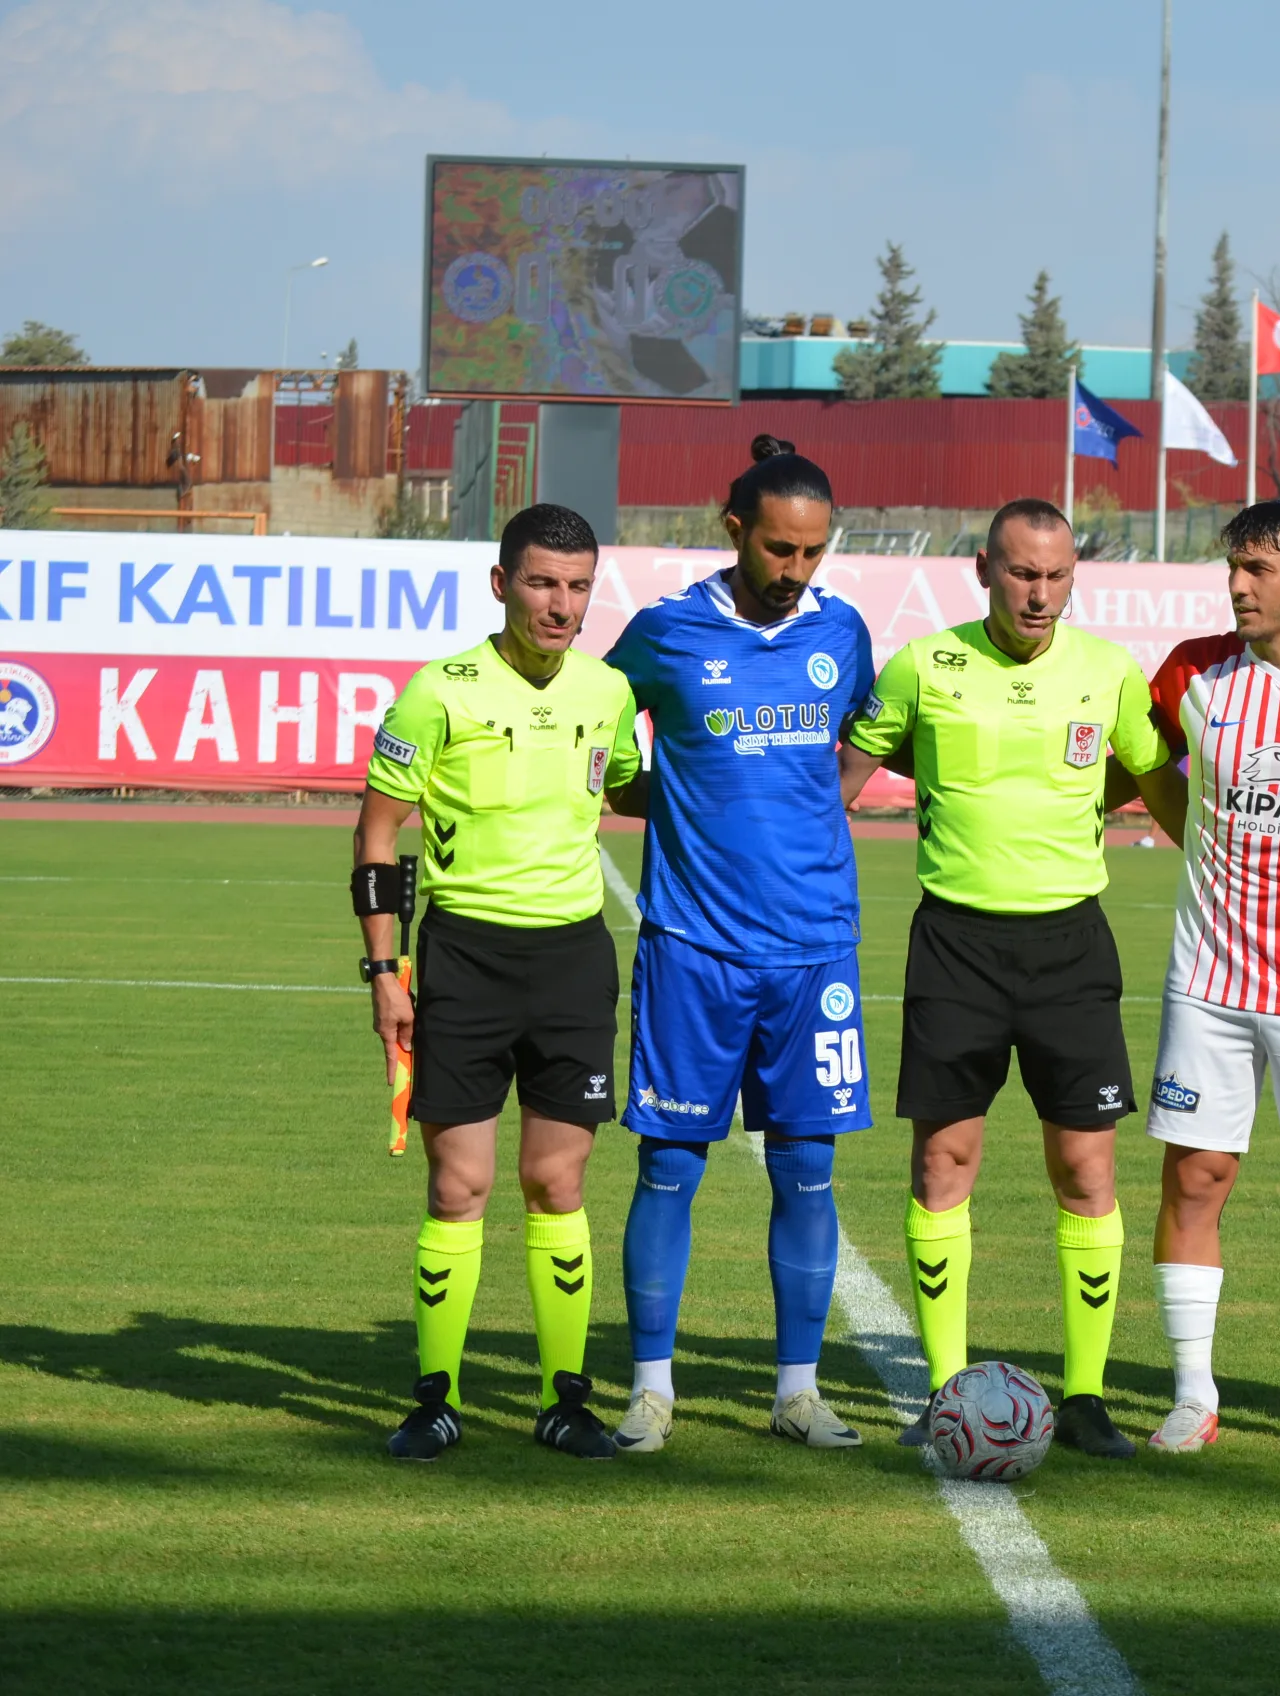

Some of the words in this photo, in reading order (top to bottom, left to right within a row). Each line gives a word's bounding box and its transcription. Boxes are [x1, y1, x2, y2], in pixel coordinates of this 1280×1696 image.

[118, 562, 459, 631] KATILIM
[702, 677, 731, 685] hummel
[1007, 697, 1036, 706] hummel
[736, 703, 829, 731] LOTUS
[529, 723, 557, 731] hummel
[738, 734, 769, 747] KIYI
[1072, 752, 1092, 763] TFF
[814, 1028, 863, 1087] 50
[584, 1090, 607, 1099] hummel
[831, 1103, 857, 1115] hummel
[1098, 1099, 1123, 1111] hummel
